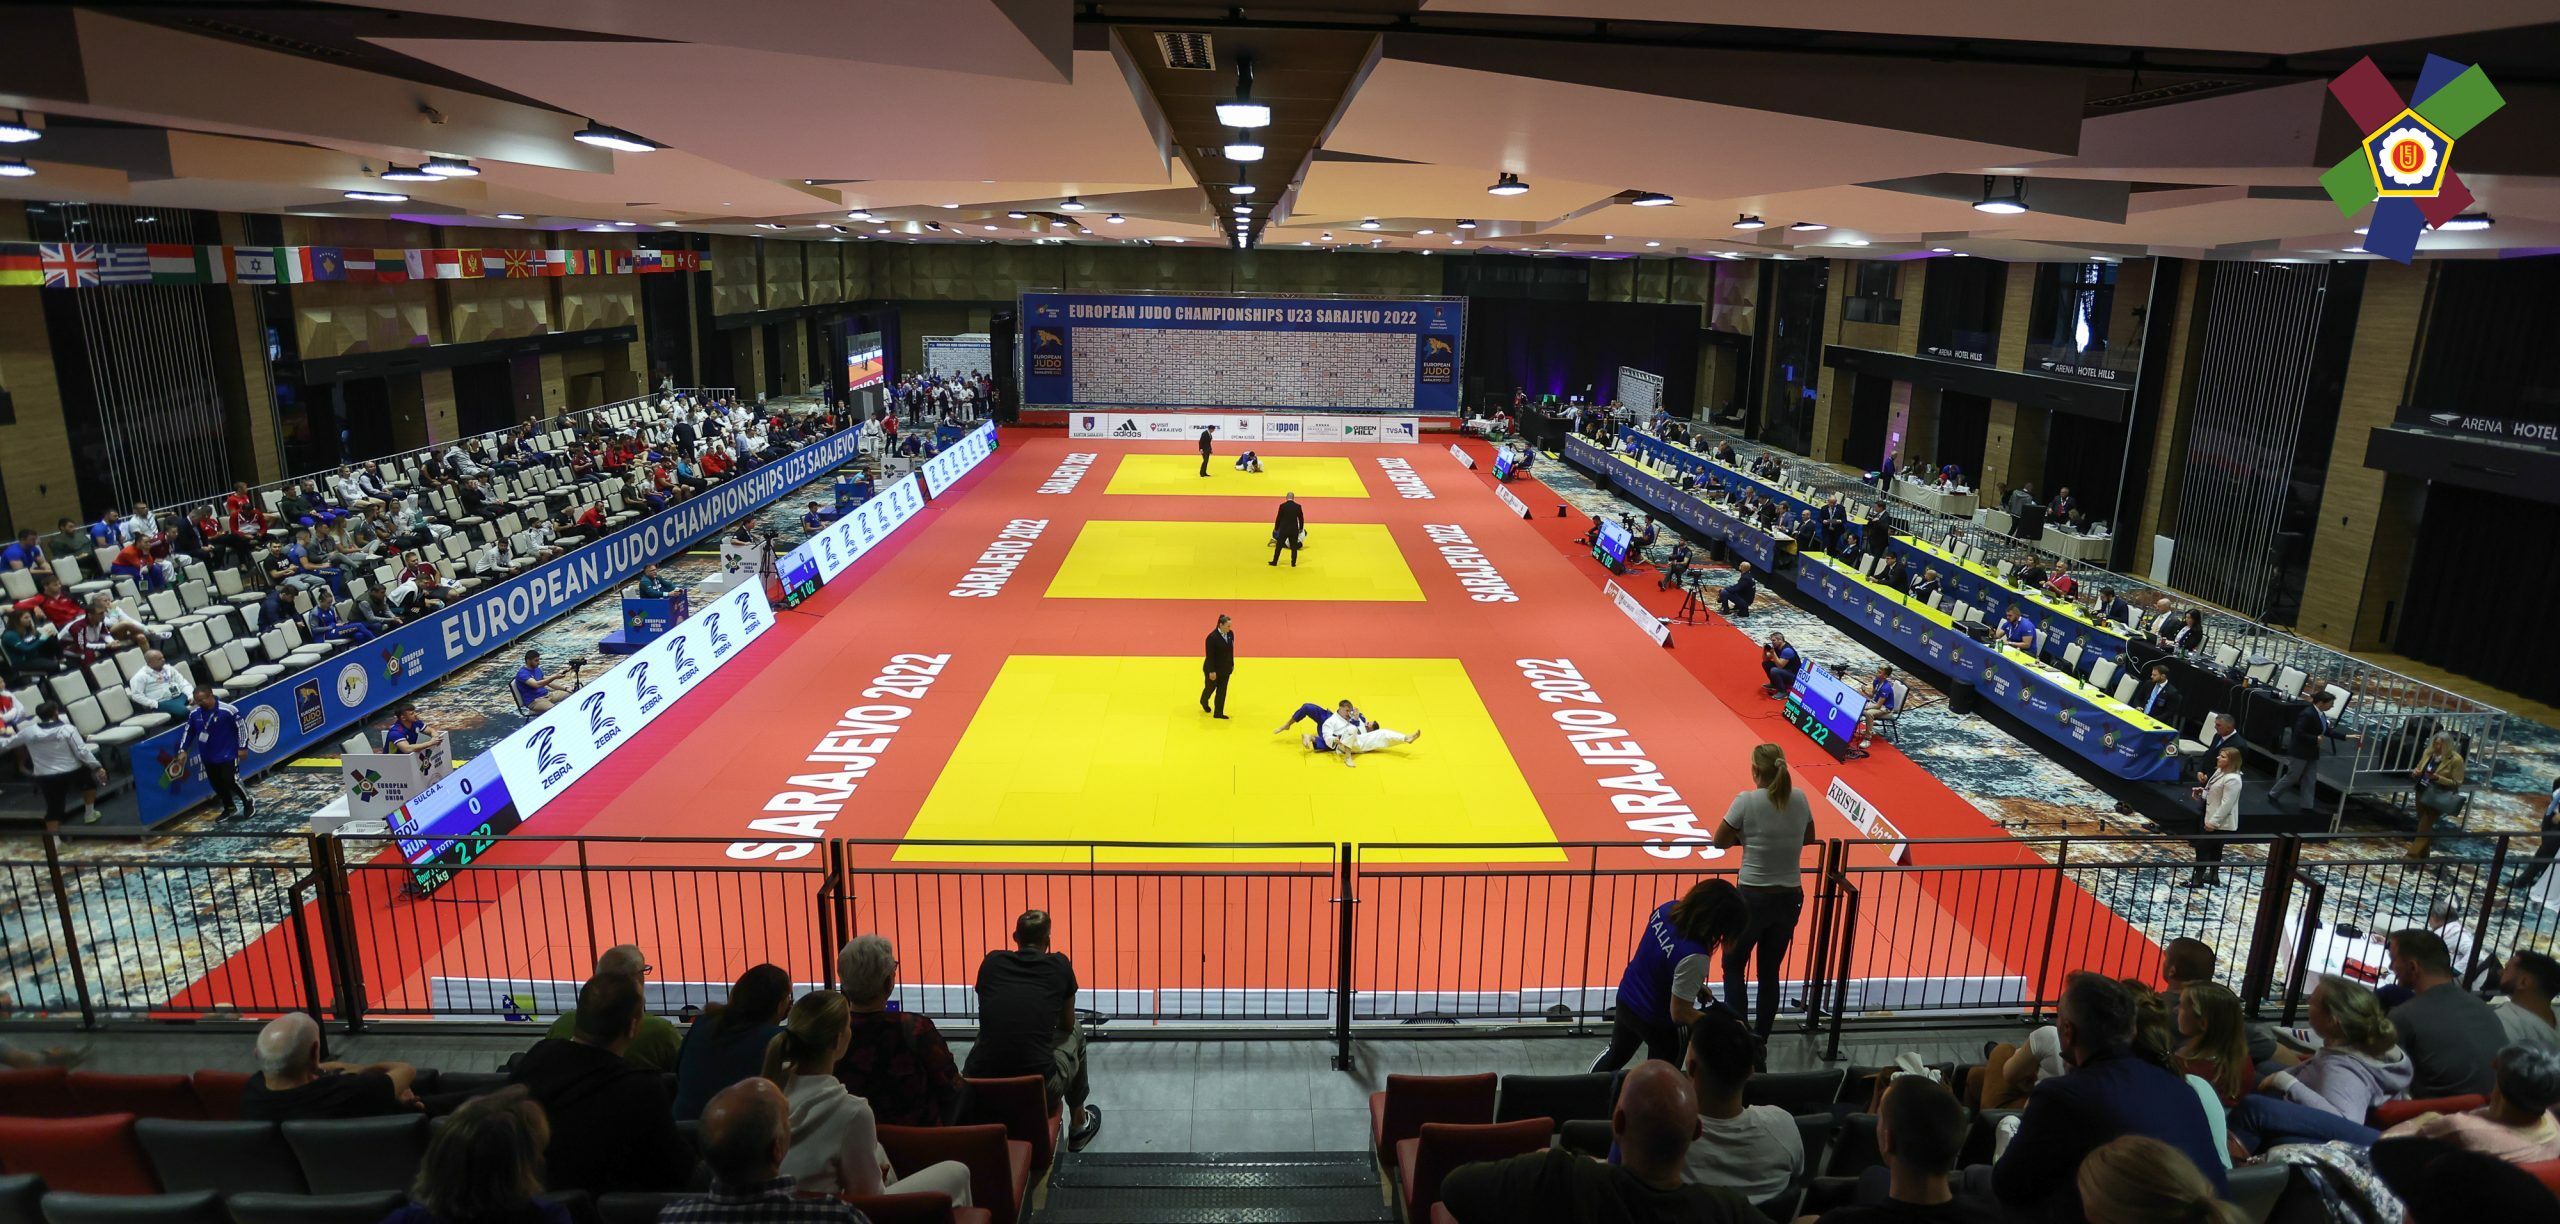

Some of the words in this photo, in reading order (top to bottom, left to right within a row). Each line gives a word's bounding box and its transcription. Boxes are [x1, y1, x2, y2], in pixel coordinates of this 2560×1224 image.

[1070, 304, 1134, 319] EUROPEAN
[1139, 306, 1170, 320] JUDO
[1176, 306, 1284, 322] CHAMPIONSHIPS
[1288, 309, 1312, 323] U23
[1316, 310, 1380, 324] SARAJEVO
[1384, 312, 1416, 326] 2022
[1938, 348, 1952, 357] ARENA
[1954, 350, 1969, 360] HOTEL
[1970, 353, 1982, 362] HILLS
[2055, 364, 2074, 374] ARENA
[2078, 366, 2096, 378] HOTEL
[2098, 369, 2114, 380] HILLS
[1113, 430, 1142, 438] adidas
[2461, 417, 2502, 433] ARENA
[2513, 422, 2558, 440] HOTEL
[1062, 452, 1098, 465] 2022
[1036, 465, 1089, 494] SARAJEVO
[1422, 524, 1474, 544] 2022
[442, 552, 599, 660] EUROPEAN
[604, 525, 659, 580] JUDO
[663, 465, 783, 548] CHAMPIONSHIPS
[786, 458, 806, 486] U23
[807, 434, 854, 474] SARAJEVO
[948, 540, 1034, 598] SARAJEVO
[998, 518, 1050, 539] 2022
[1438, 546, 1520, 603] SARAJEVO
[806, 580, 815, 594] 02
[744, 620, 761, 635] ZEBRA
[402, 648, 424, 664] EUROPEAN
[714, 640, 732, 658] ZEBRA
[408, 665, 423, 677] UNION
[678, 666, 699, 685] ZEBRA
[1797, 669, 1811, 683] ROU
[1515, 658, 1603, 703] 2022
[1793, 681, 1807, 694] HUN
[640, 693, 663, 715] ZEBRA
[1835, 692, 1843, 705] 0
[303, 710, 321, 724] JUDO
[1790, 713, 1797, 724] kg
[1828, 706, 1837, 720] 0
[594, 725, 622, 749] ZEBRA
[1802, 716, 1813, 734] 2
[1811, 723, 1829, 746] 22
[725, 704, 912, 861] SARAJEVO
[861, 653, 952, 700] 2022
[541, 762, 574, 790] ZEBRA
[1551, 709, 1726, 860] SARAJEVO
[460, 778, 472, 795] 0
[414, 788, 436, 805] SULCA
[469, 797, 481, 814] 0
[402, 836, 428, 859] HUN
[455, 842, 472, 865] 2
[471, 823, 495, 855] 22
[436, 870, 449, 881] kg
[1650, 909, 1675, 959] ITALIA
